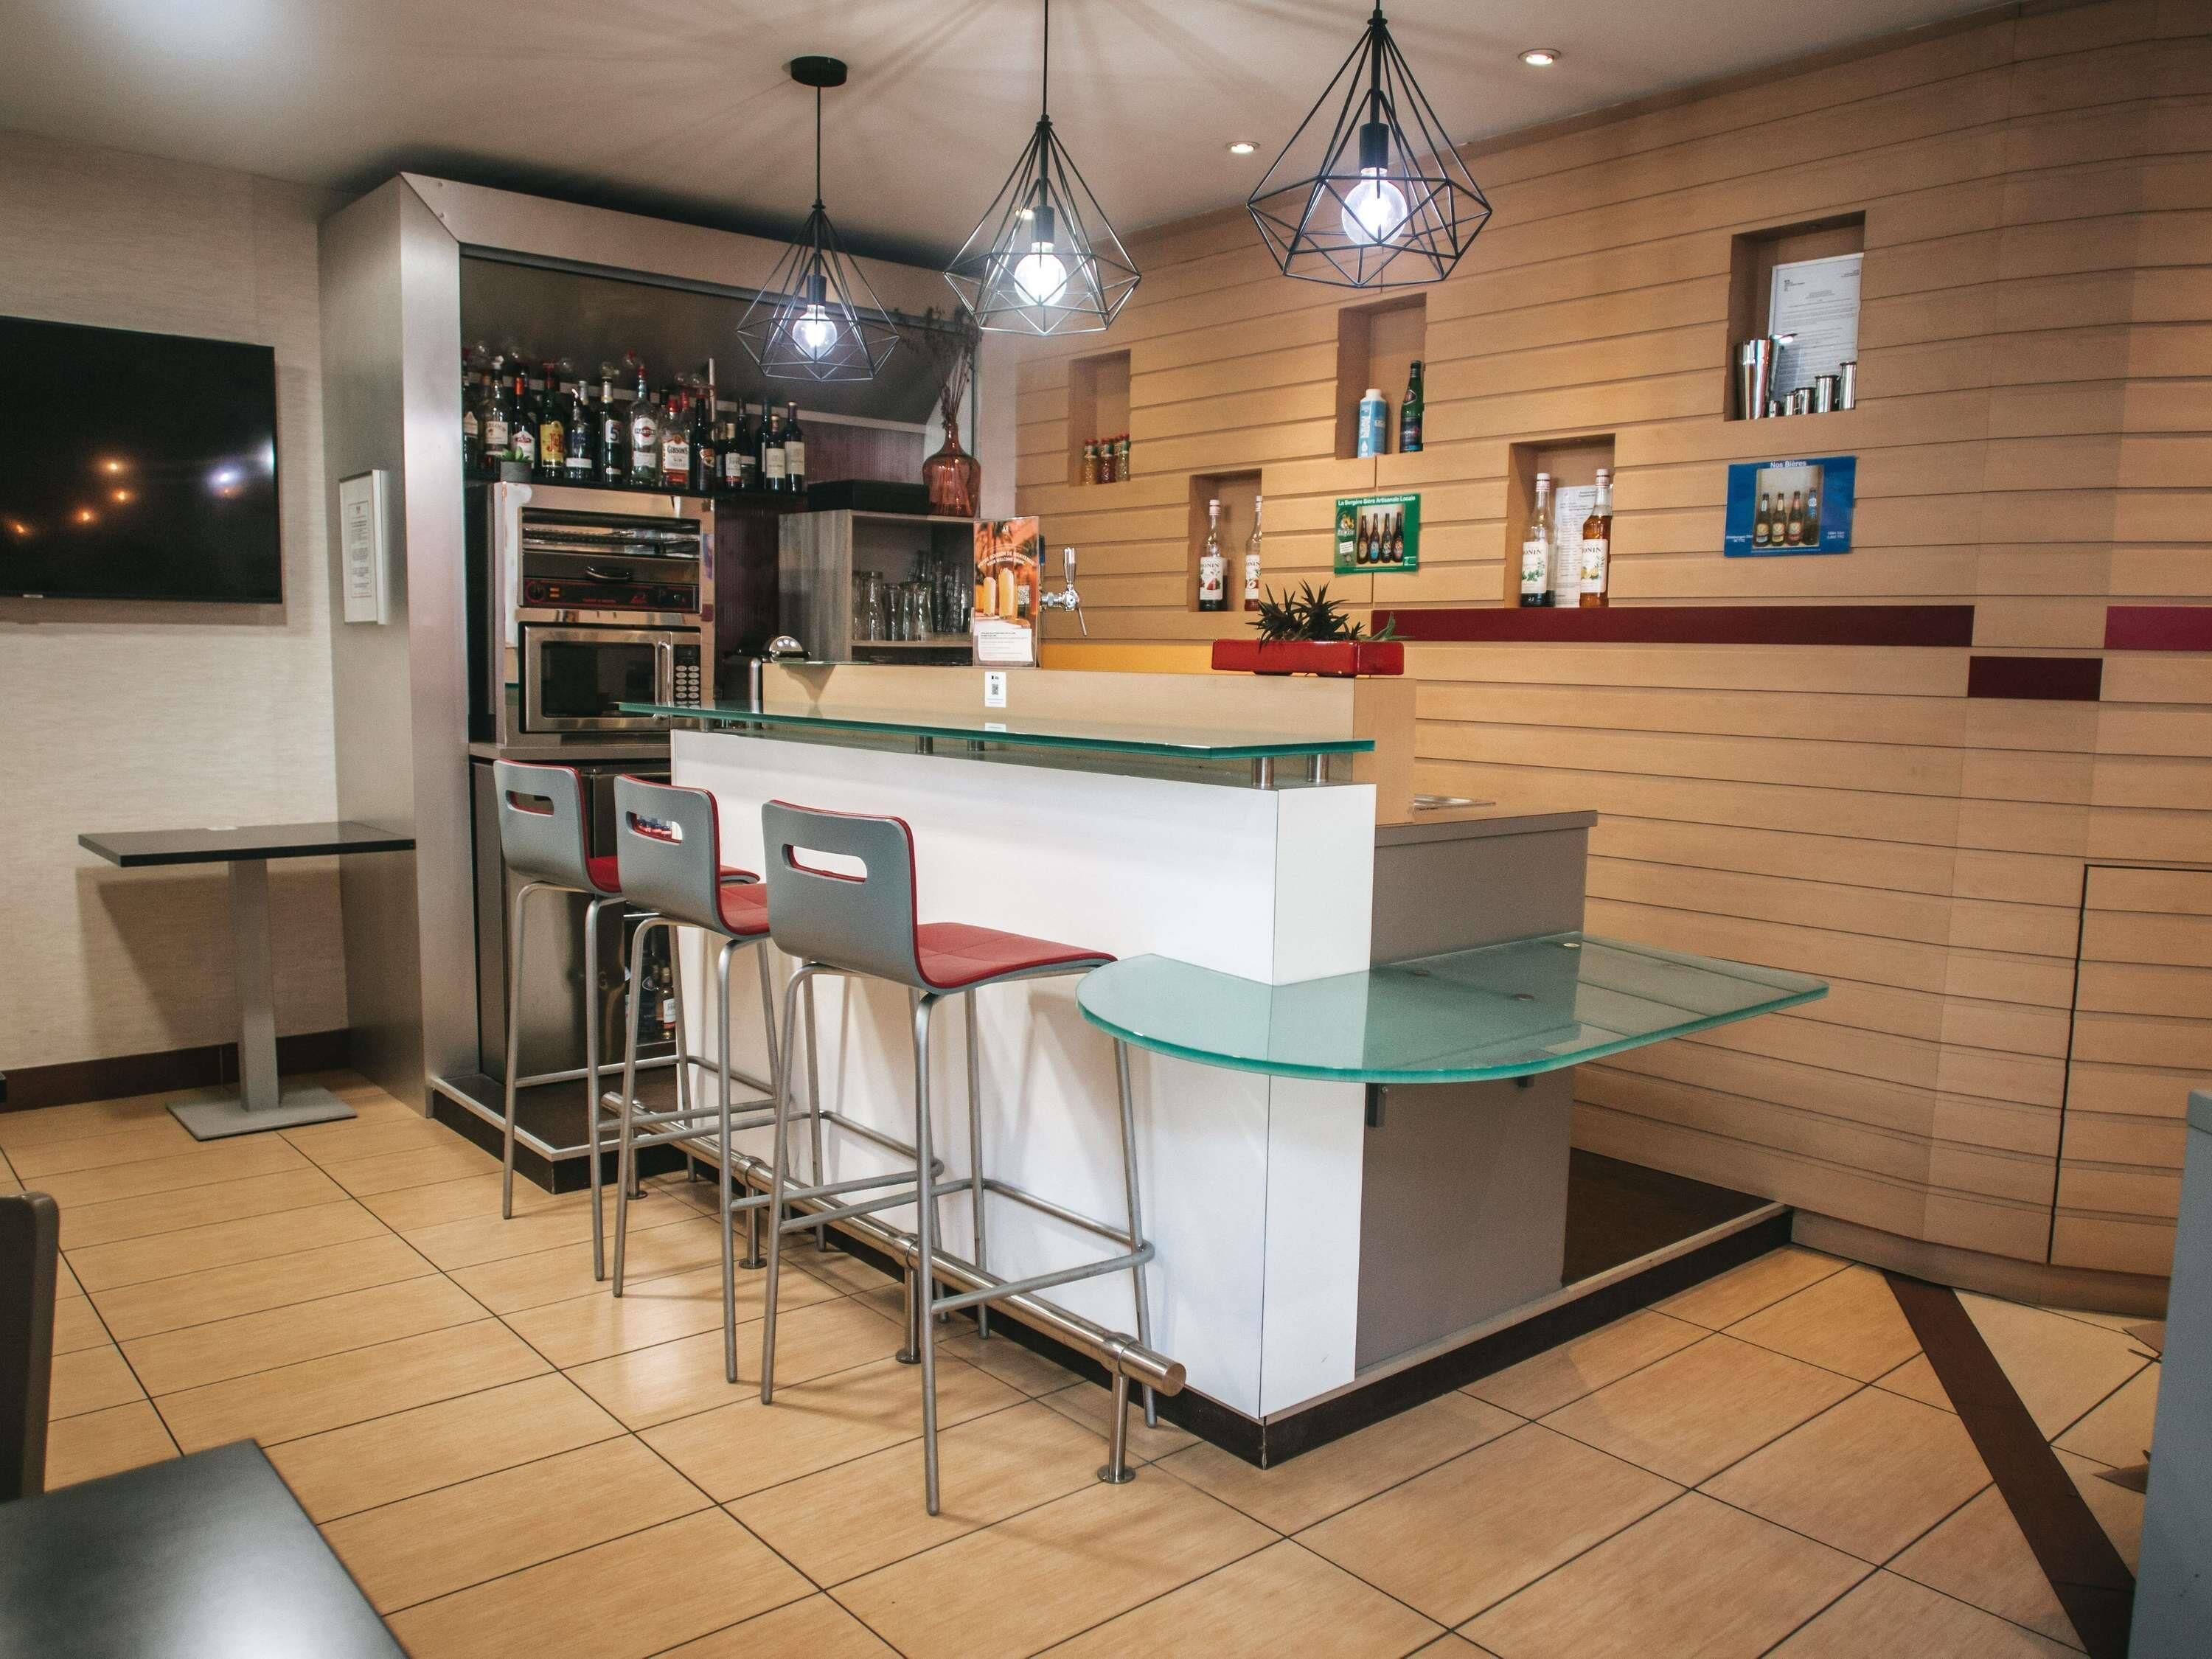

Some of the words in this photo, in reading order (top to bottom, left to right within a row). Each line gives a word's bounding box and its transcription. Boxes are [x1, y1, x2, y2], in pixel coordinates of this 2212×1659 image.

[1785, 459, 1806, 467] Bières
[1523, 547, 1542, 555] ONIN
[1582, 546, 1601, 554] ONIN
